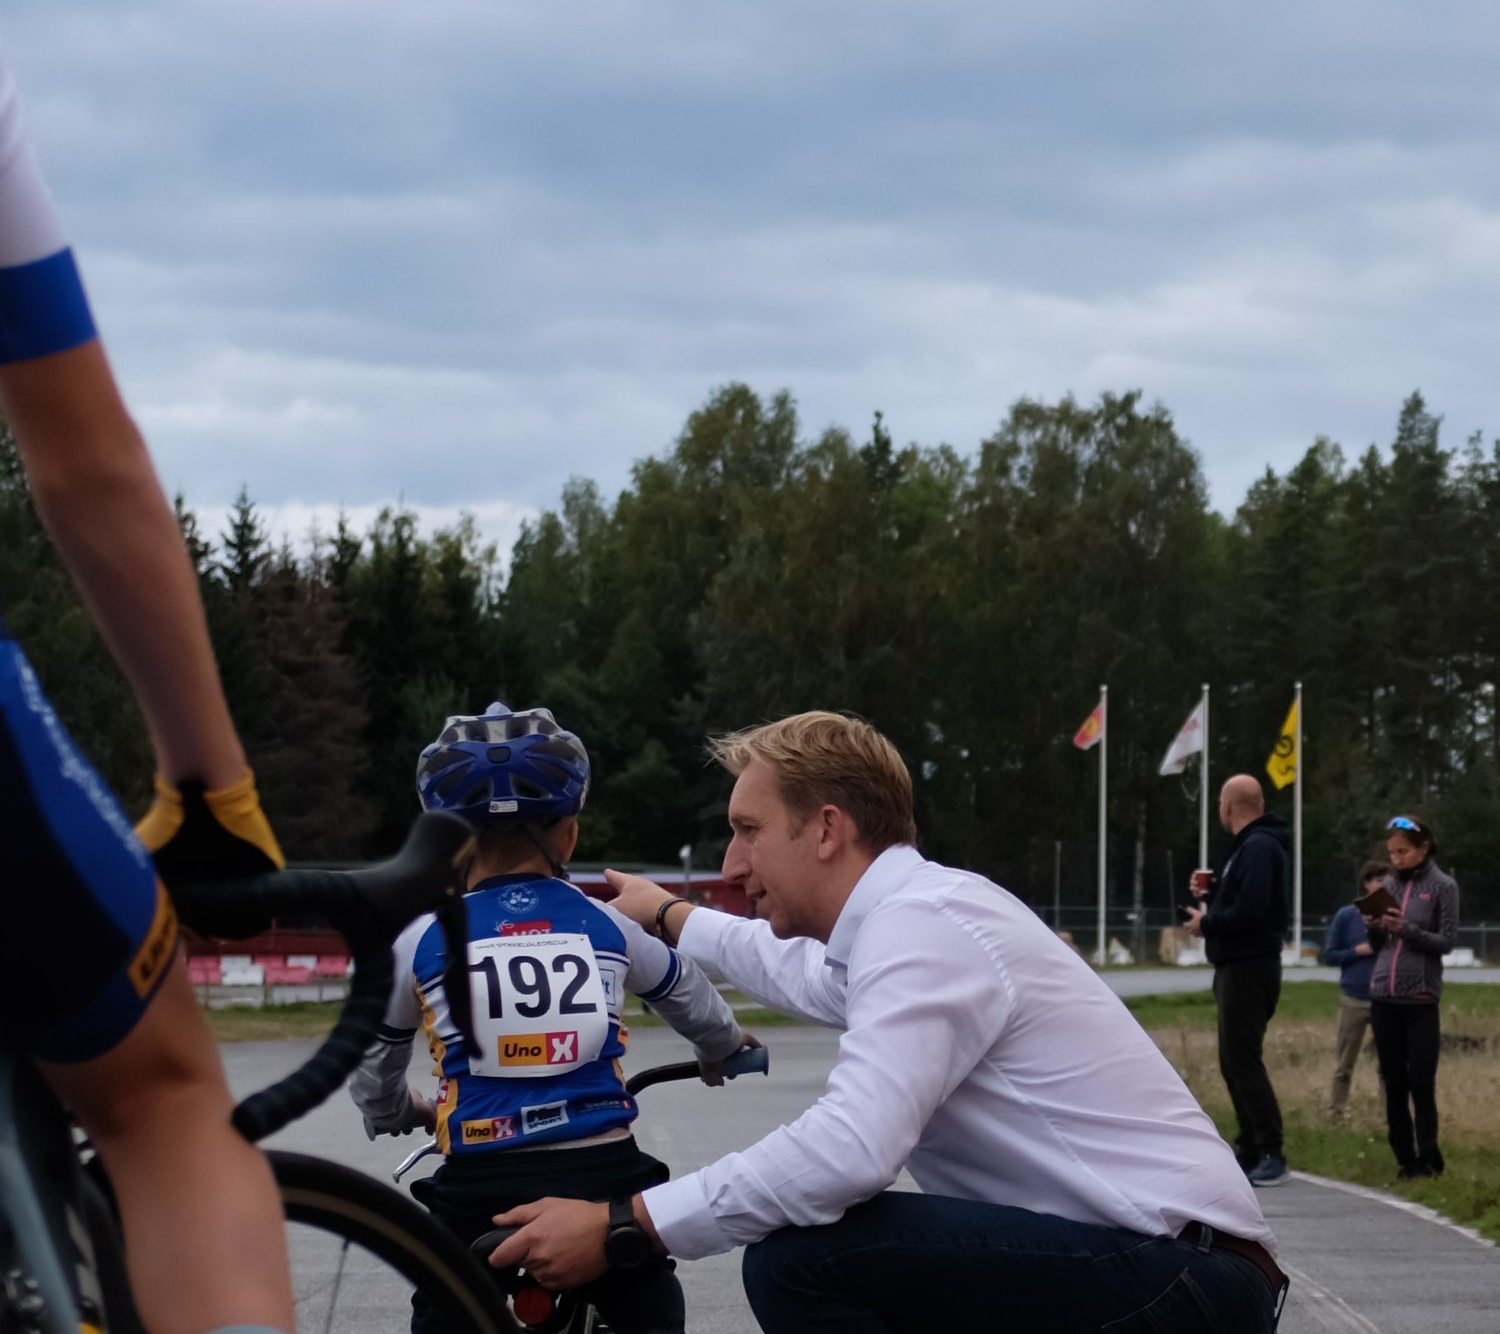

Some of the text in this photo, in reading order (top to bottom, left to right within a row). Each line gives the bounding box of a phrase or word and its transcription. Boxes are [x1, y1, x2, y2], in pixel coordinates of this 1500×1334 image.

[468, 954, 598, 1020] 192
[504, 1033, 576, 1063] Uno X
[466, 1118, 514, 1138] Uno X
